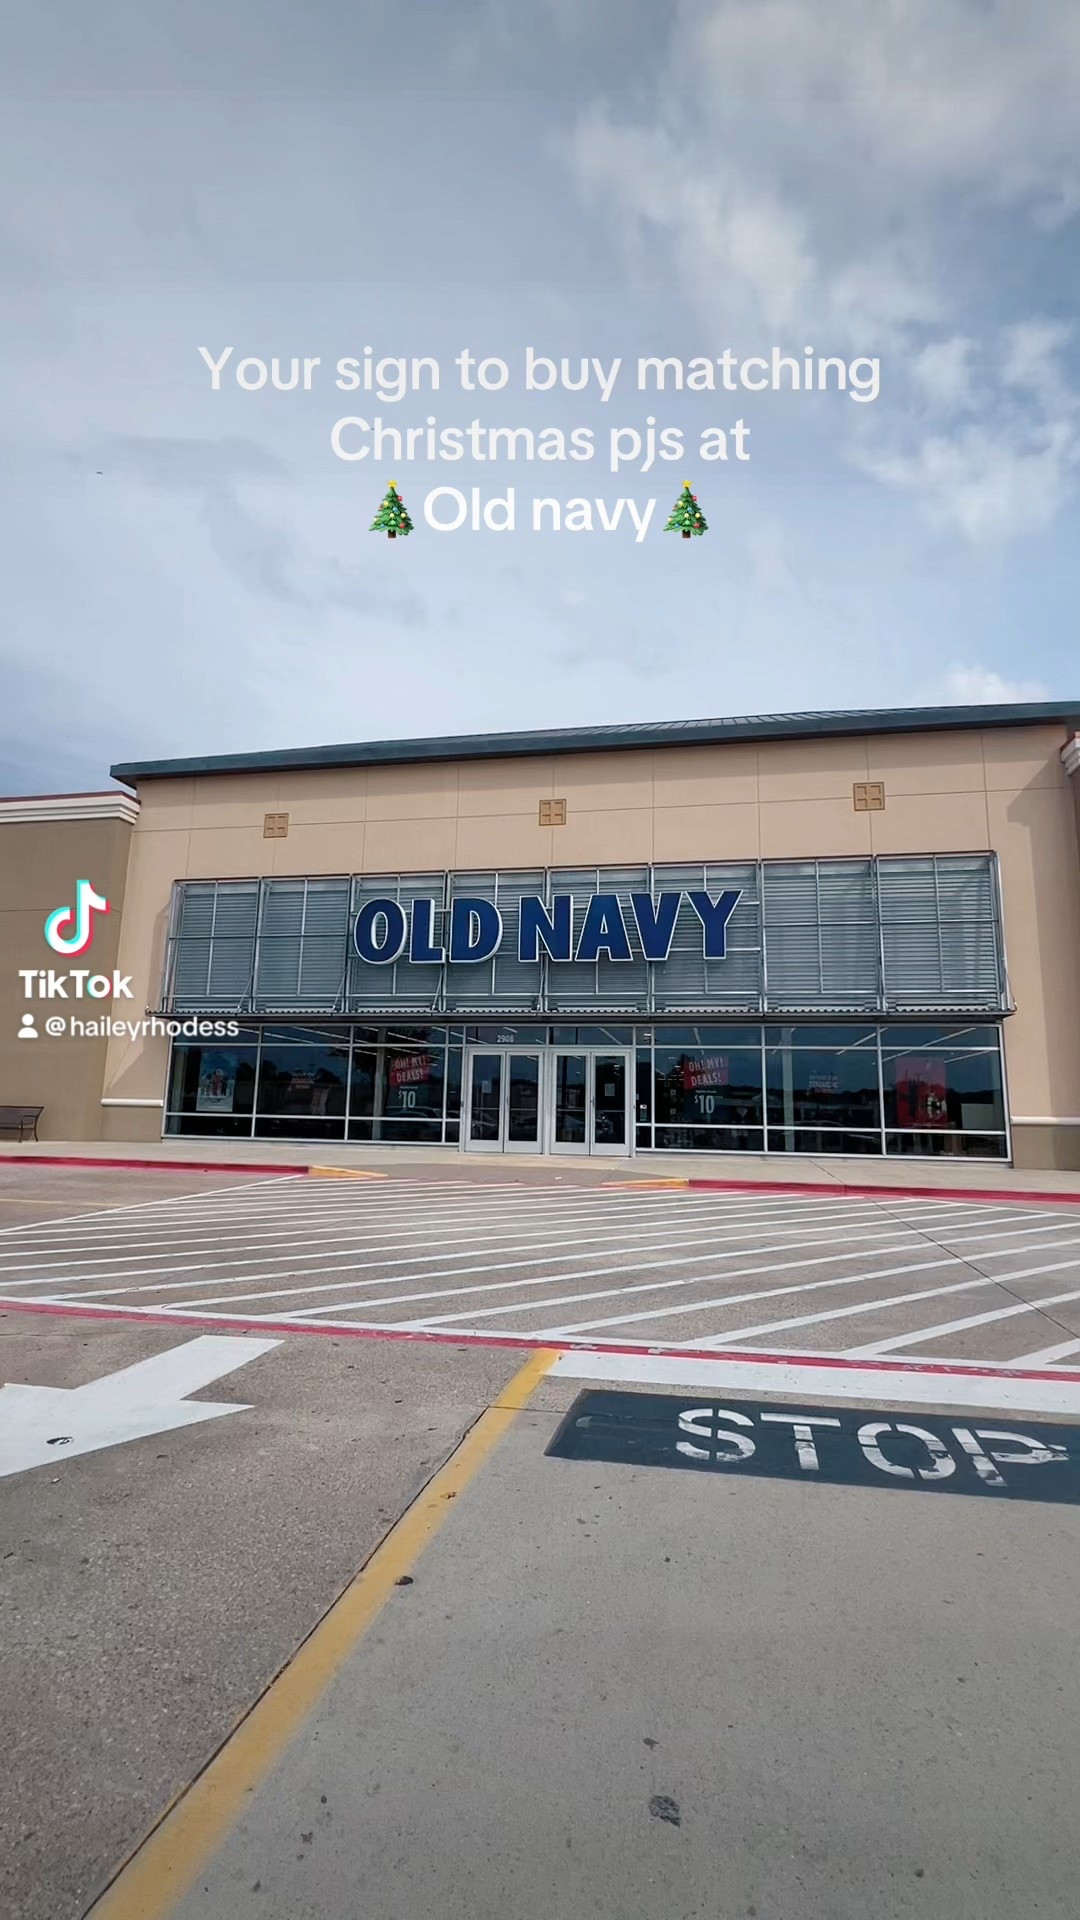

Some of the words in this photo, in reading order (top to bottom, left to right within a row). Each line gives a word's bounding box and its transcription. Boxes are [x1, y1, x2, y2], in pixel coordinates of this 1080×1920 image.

[354, 896, 504, 965] OLD
[518, 890, 744, 963] NAVY
[396, 1069, 424, 1083] DEALS!
[691, 1072, 722, 1087] DEALS!
[398, 1090, 416, 1108] $10
[694, 1095, 715, 1114] $10
[676, 1407, 1070, 1488] STOP
